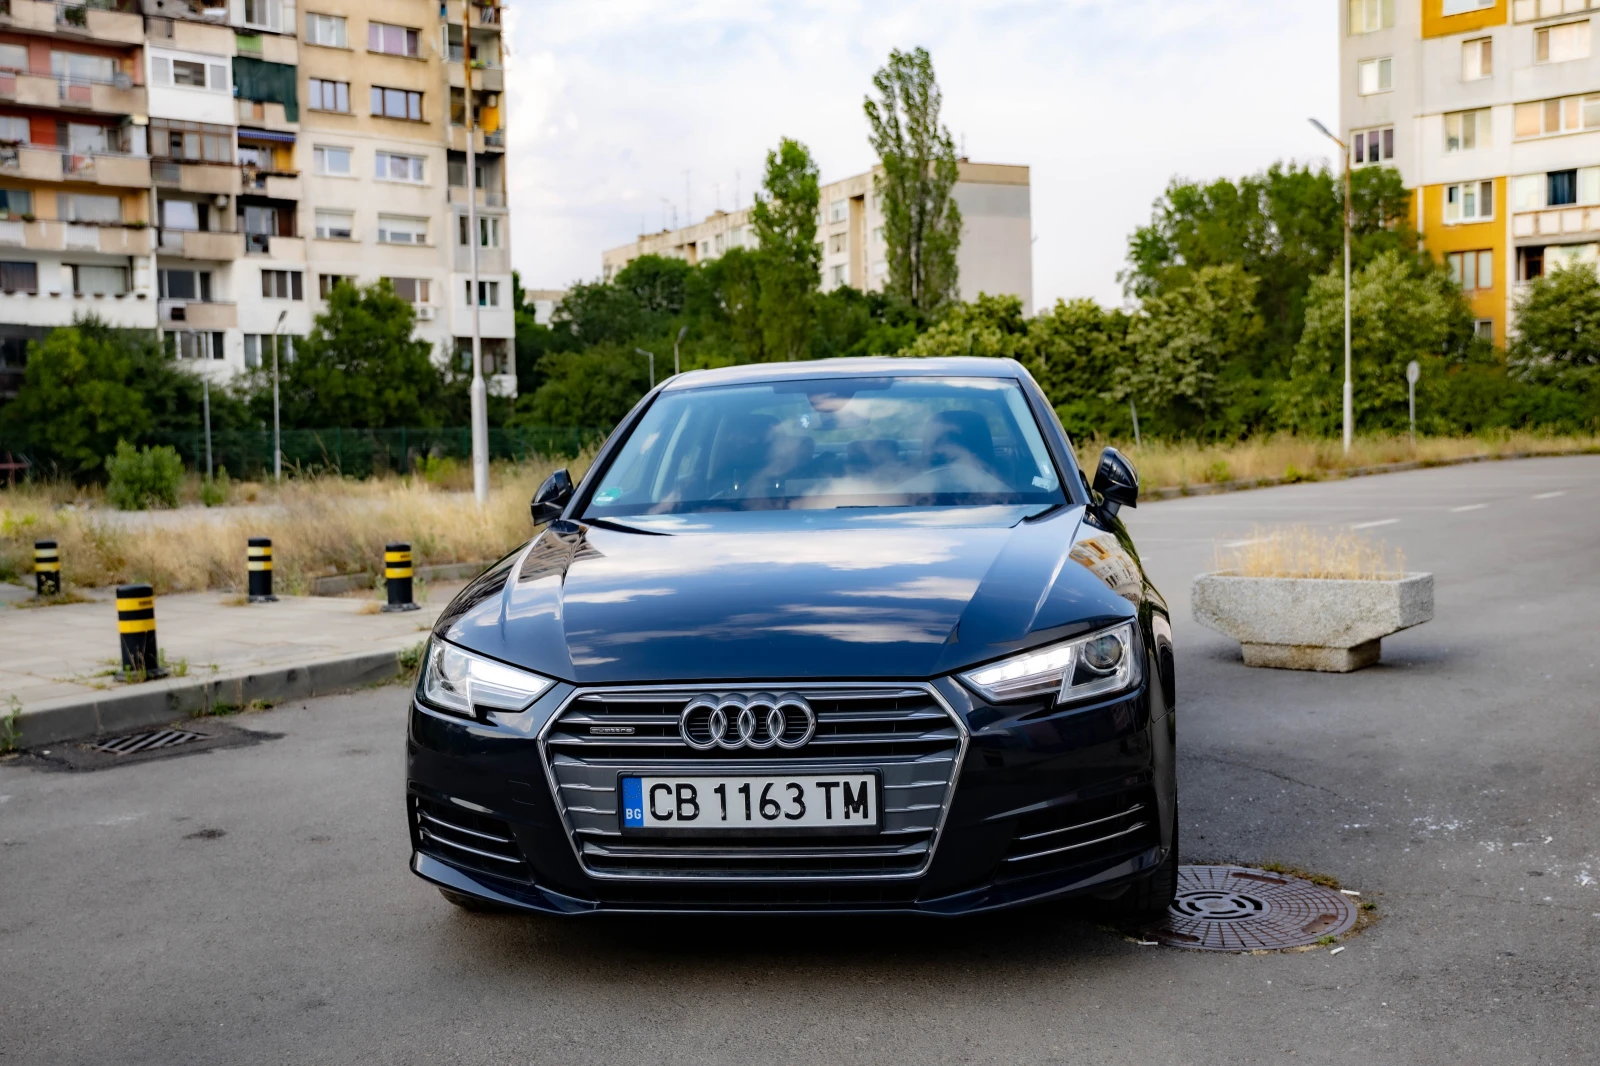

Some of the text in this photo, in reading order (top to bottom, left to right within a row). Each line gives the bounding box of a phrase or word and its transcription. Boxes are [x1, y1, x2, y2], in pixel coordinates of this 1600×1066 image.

[649, 780, 869, 821] CB 1163 TM
[625, 808, 642, 820] BG
